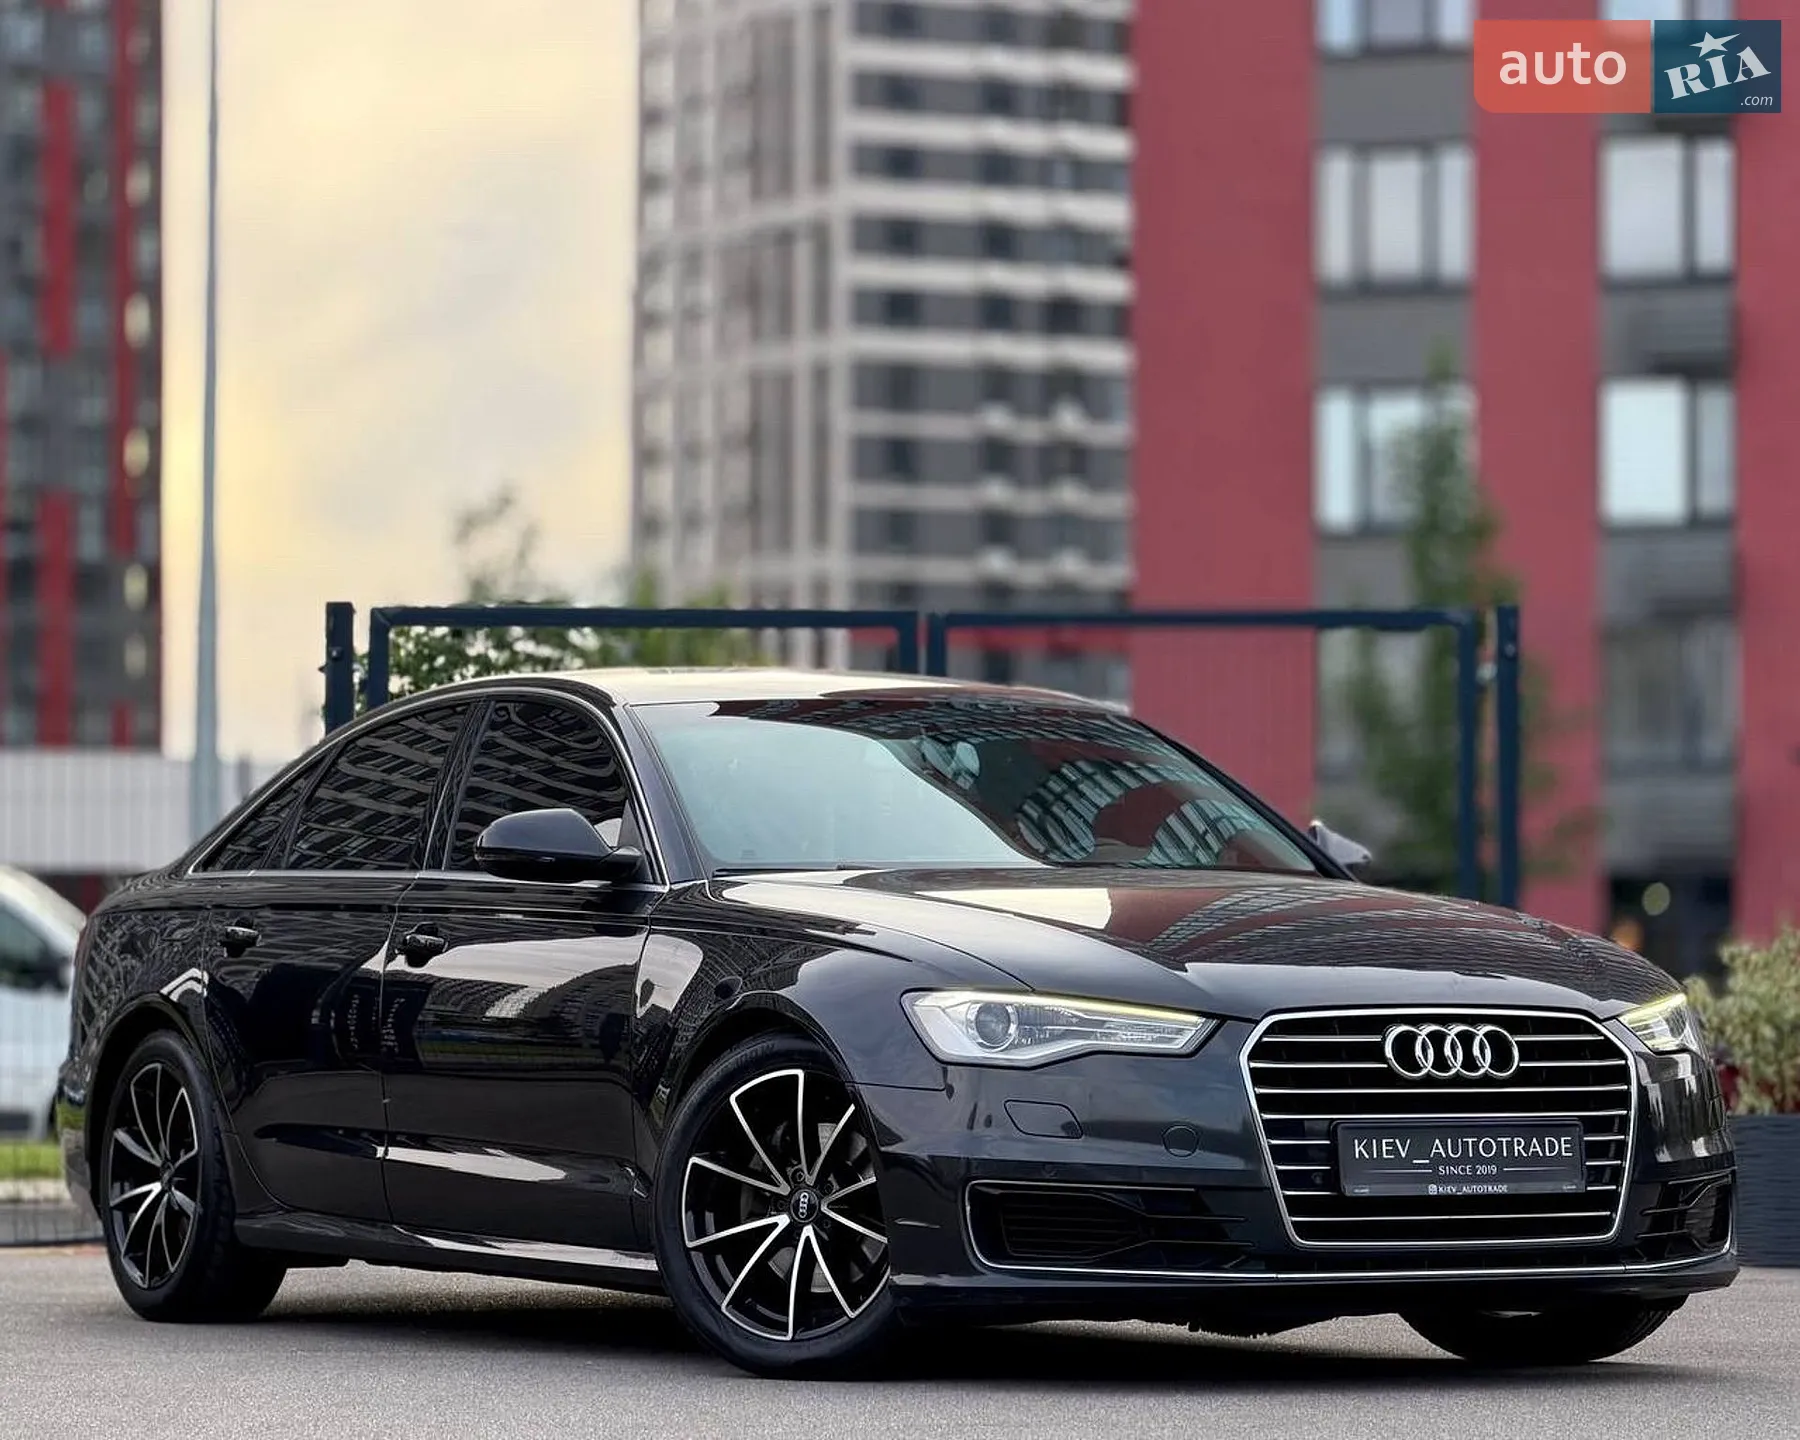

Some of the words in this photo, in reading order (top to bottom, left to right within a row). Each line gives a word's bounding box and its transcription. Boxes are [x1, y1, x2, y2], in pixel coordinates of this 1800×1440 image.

[1354, 1137, 1574, 1164] KIEV_AUTOTRADE
[1438, 1165, 1472, 1175] SINCE
[1476, 1165, 1497, 1175] 2019
[1438, 1185, 1508, 1195] KIEV_AUTOTRADE
